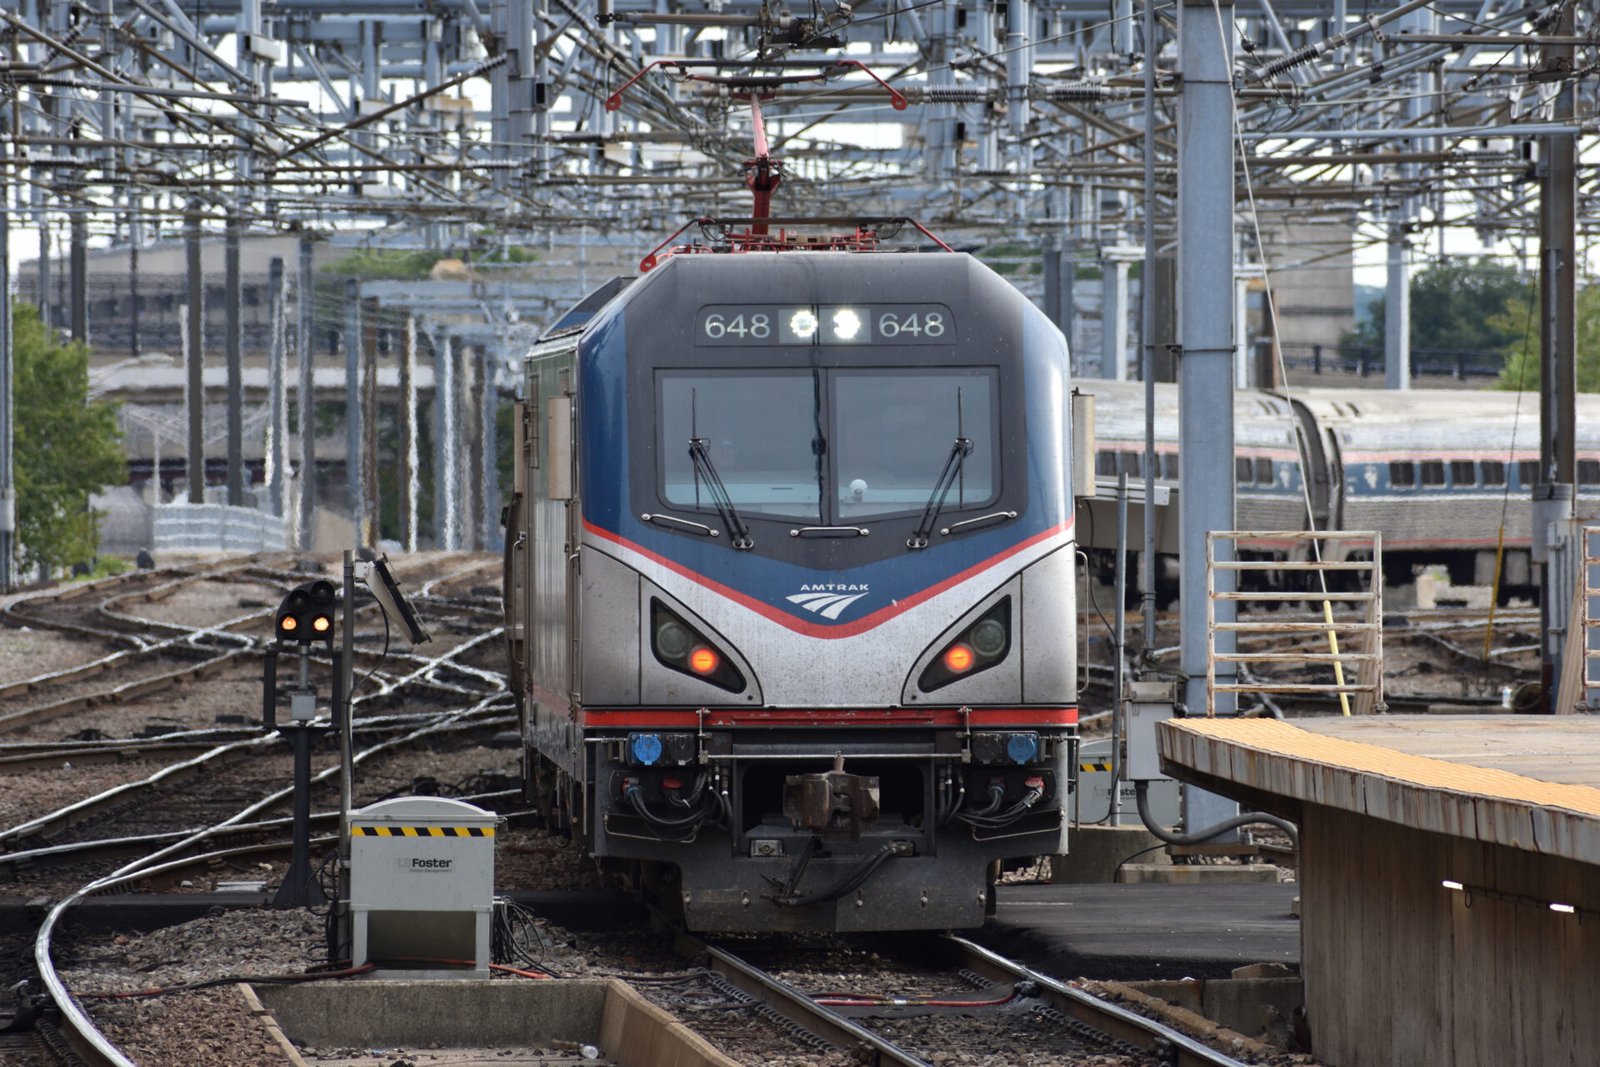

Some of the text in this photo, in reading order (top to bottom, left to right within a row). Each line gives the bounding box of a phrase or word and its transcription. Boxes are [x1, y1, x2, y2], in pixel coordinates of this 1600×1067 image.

[705, 314, 771, 339] 648
[879, 312, 945, 337] 648
[412, 858, 452, 868] Foster
